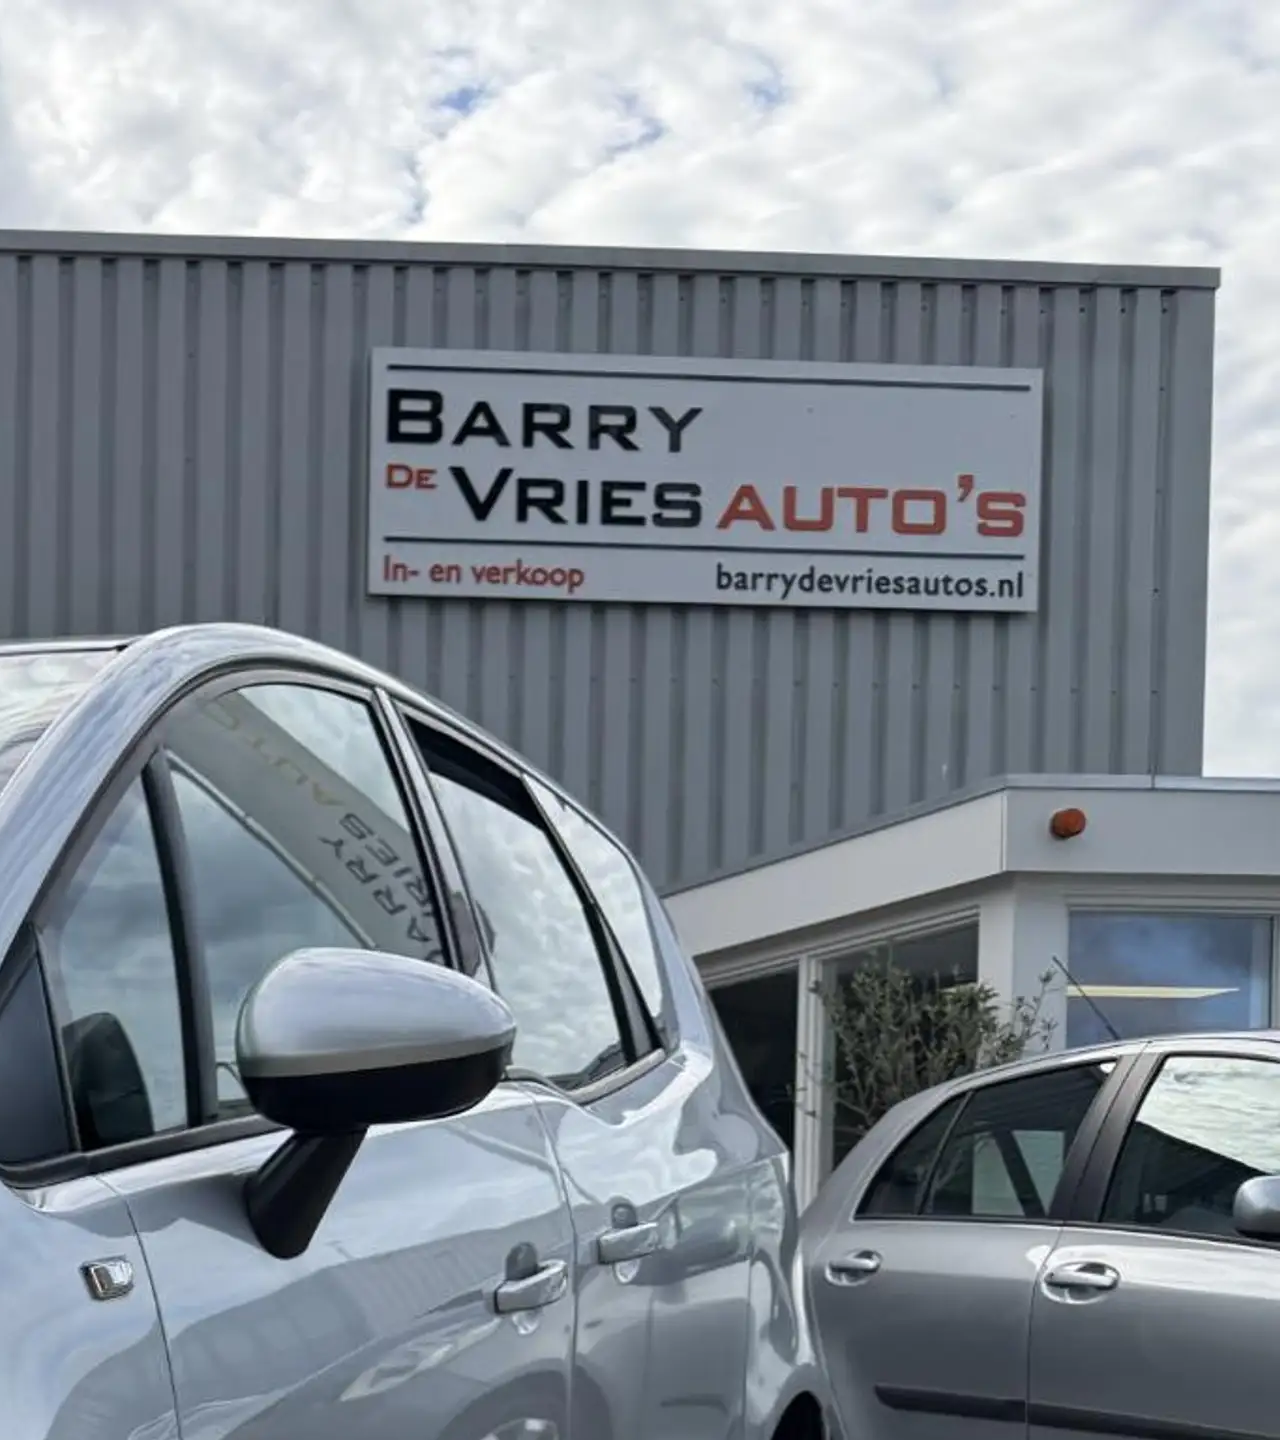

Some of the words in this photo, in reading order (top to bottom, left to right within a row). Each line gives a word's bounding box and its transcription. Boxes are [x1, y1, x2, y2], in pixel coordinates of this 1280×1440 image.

[385, 388, 703, 453] BARRY
[385, 464, 437, 490] DE
[449, 465, 702, 528] VRIES
[716, 474, 1027, 538] AUTO'S
[383, 556, 419, 584] In-
[428, 563, 462, 584] en
[470, 560, 585, 589] verkoop
[715, 562, 1025, 600] barrydevriesautos.nl
